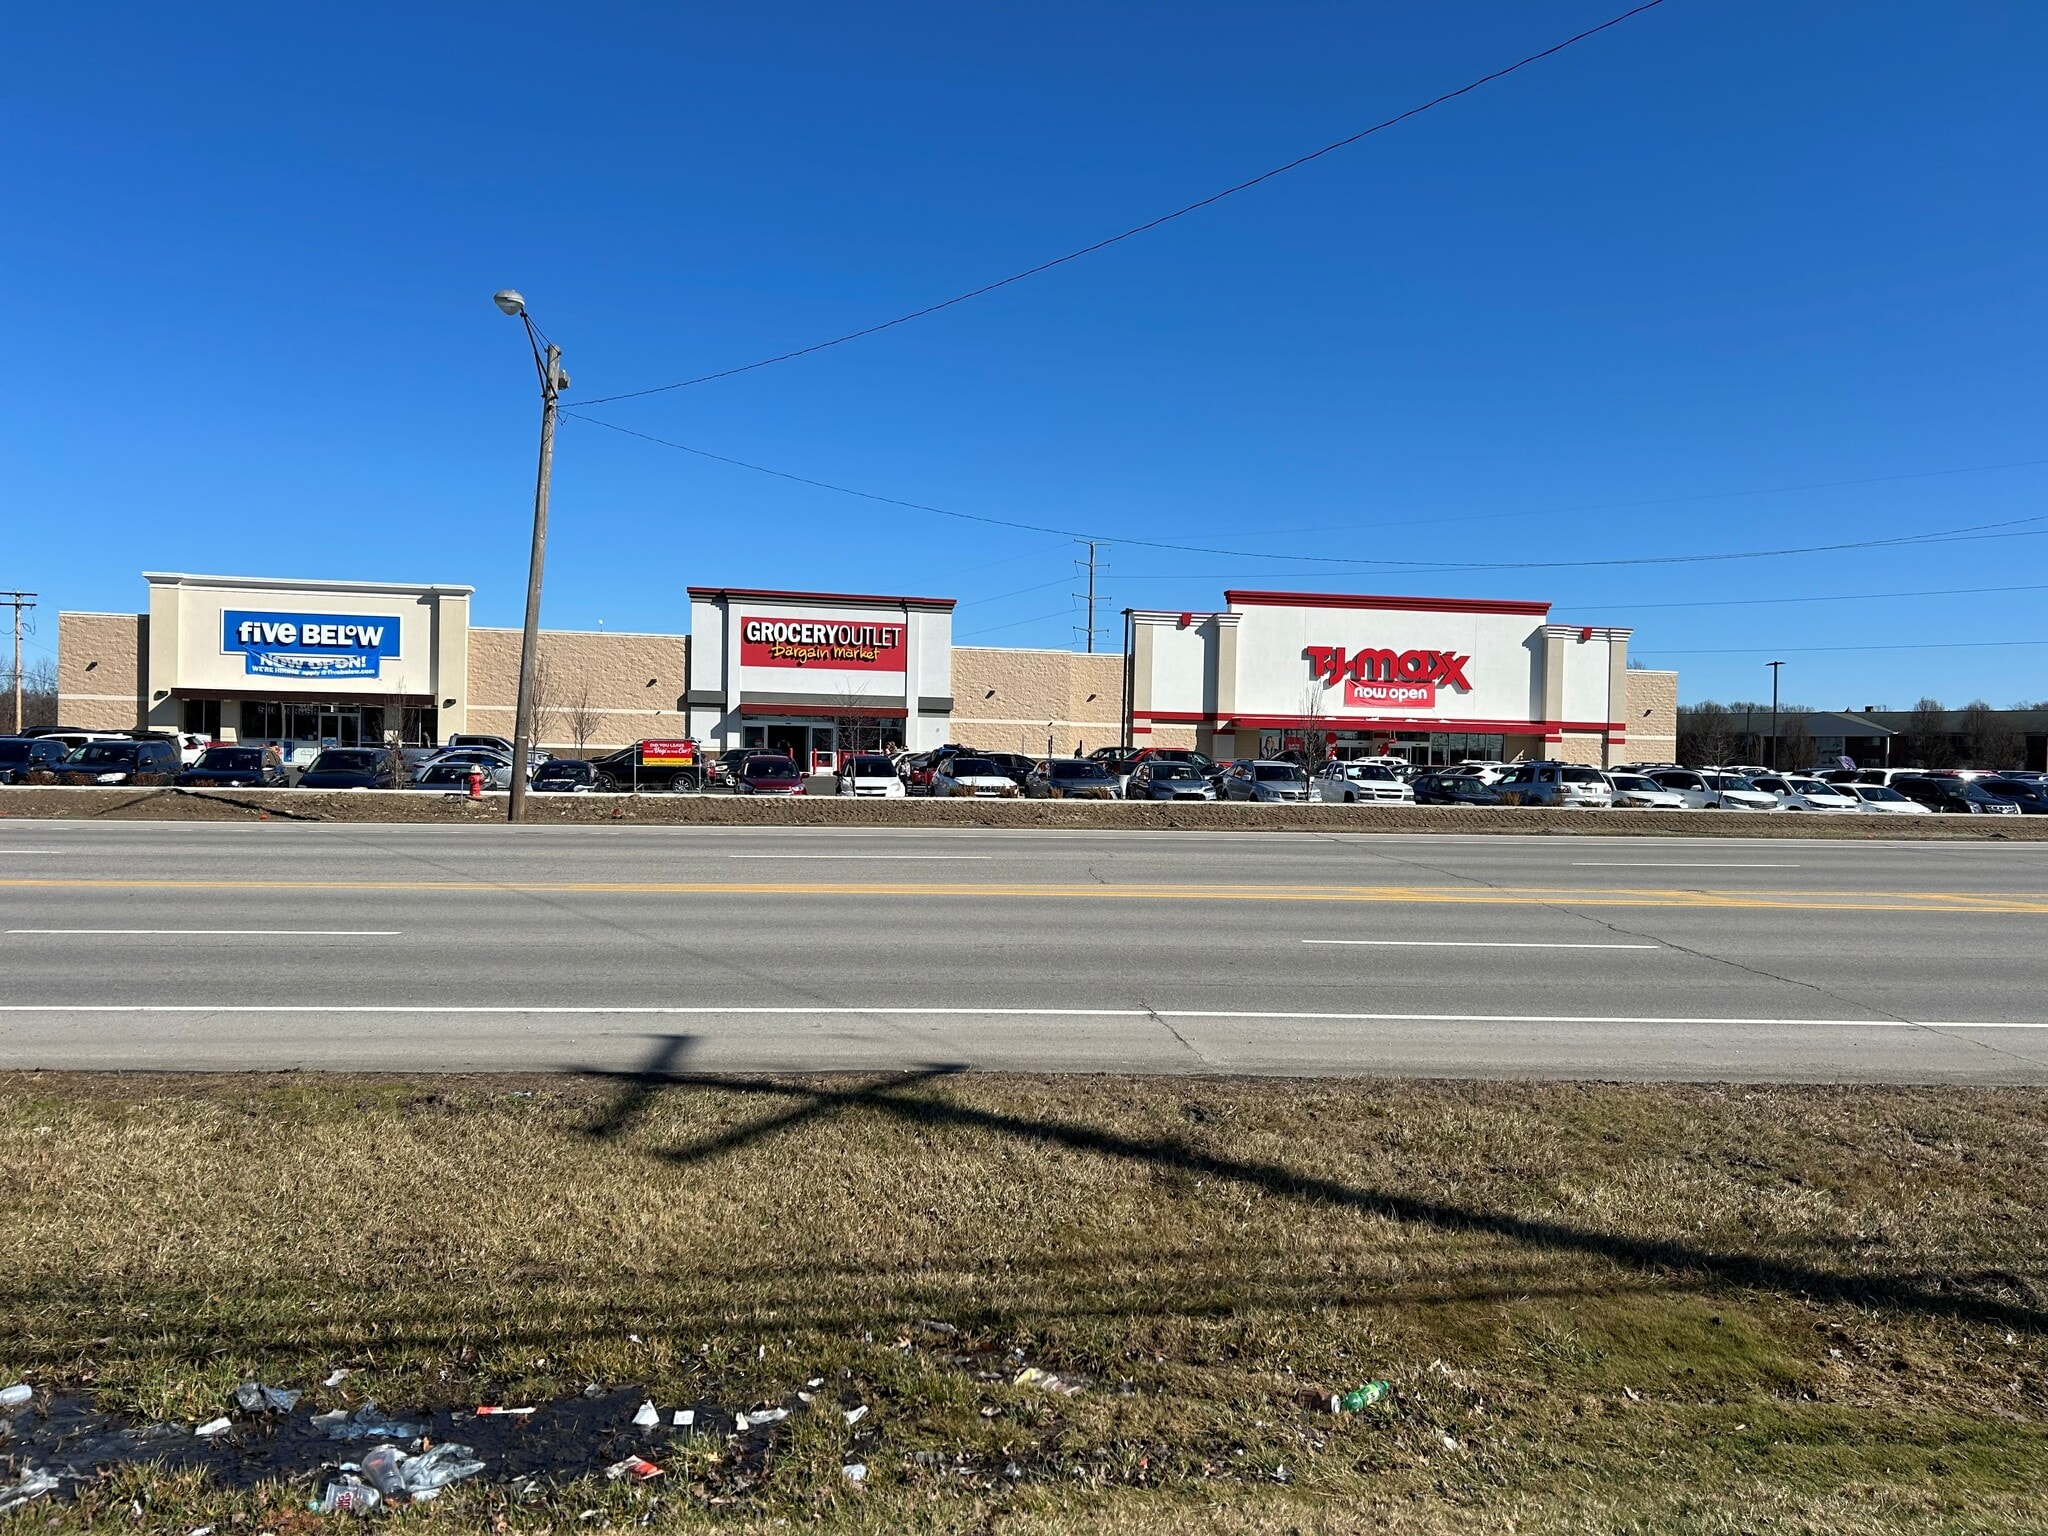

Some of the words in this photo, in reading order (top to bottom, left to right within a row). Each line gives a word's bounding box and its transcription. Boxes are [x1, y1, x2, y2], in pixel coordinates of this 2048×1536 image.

[239, 621, 297, 644] five
[302, 623, 384, 647] BELOW
[1354, 687, 1387, 699] now
[1389, 688, 1428, 703] open
